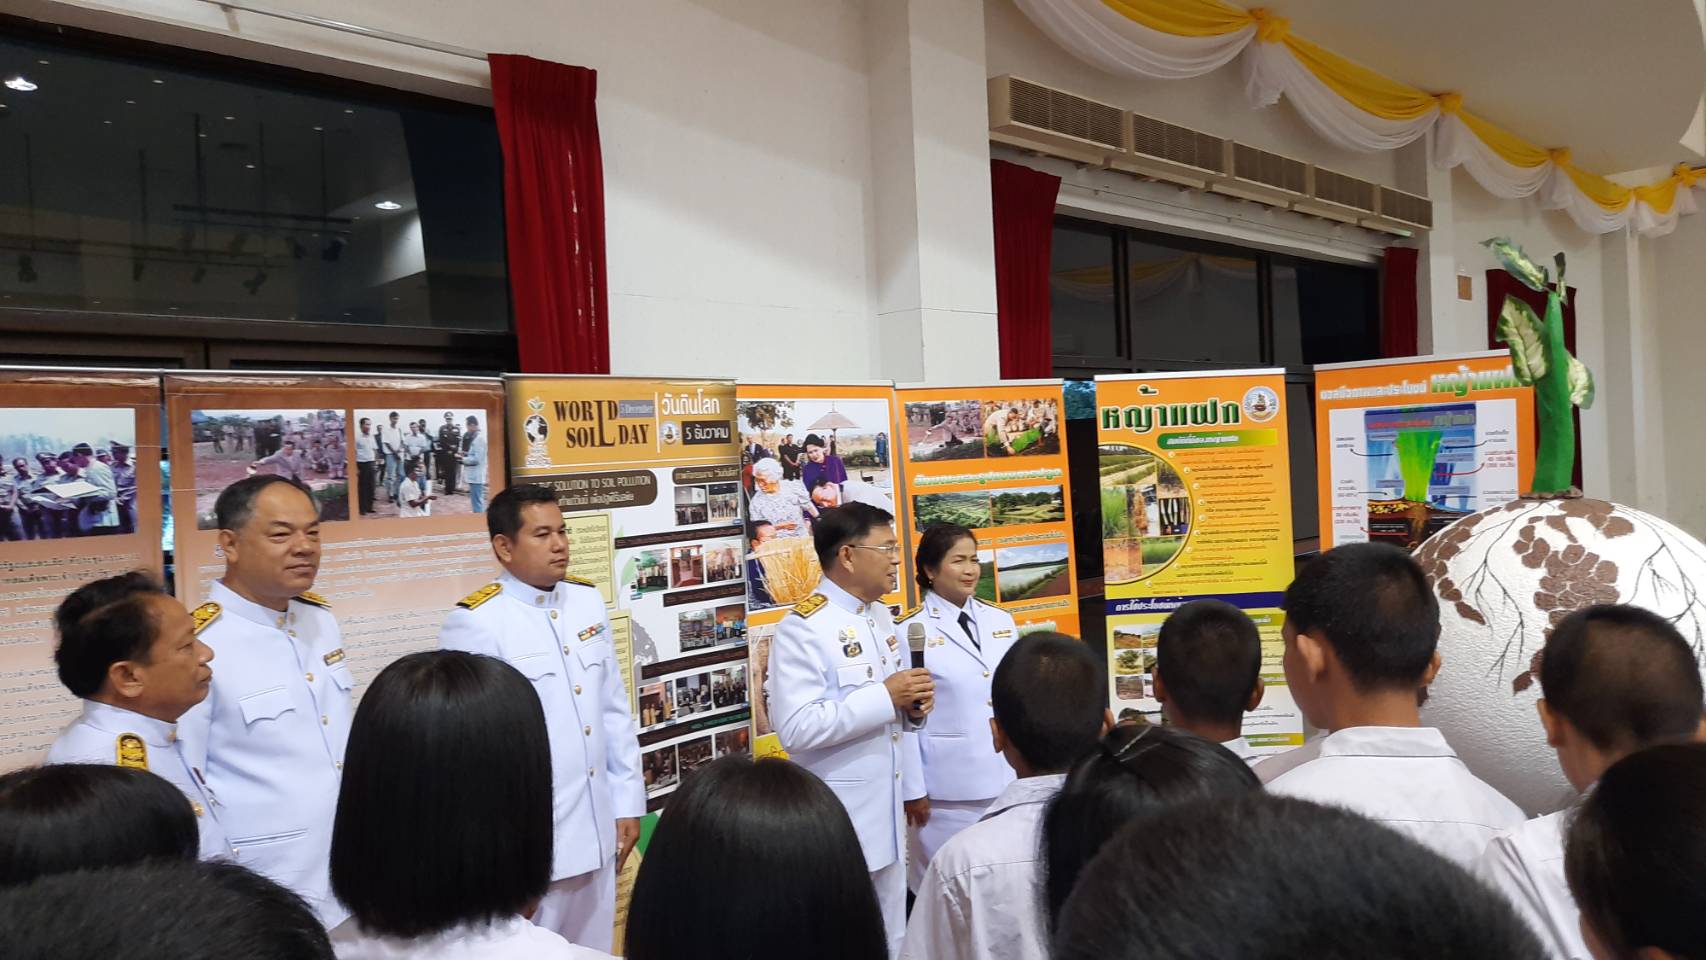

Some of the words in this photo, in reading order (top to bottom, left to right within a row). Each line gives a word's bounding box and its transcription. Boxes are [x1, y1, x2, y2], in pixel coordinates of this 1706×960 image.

[554, 400, 618, 425] WORLD
[662, 389, 720, 415] วันดินโลก
[1101, 385, 1242, 433] หญ้าแฝก
[566, 425, 615, 448] SOIL
[618, 424, 649, 445] DAY
[685, 427, 692, 440] 5
[694, 424, 729, 440] ธันวาคม
[554, 479, 589, 491] SOLUTION
[591, 478, 600, 488] TO
[601, 477, 616, 488] SOIL
[617, 475, 651, 486] POLLUTION
